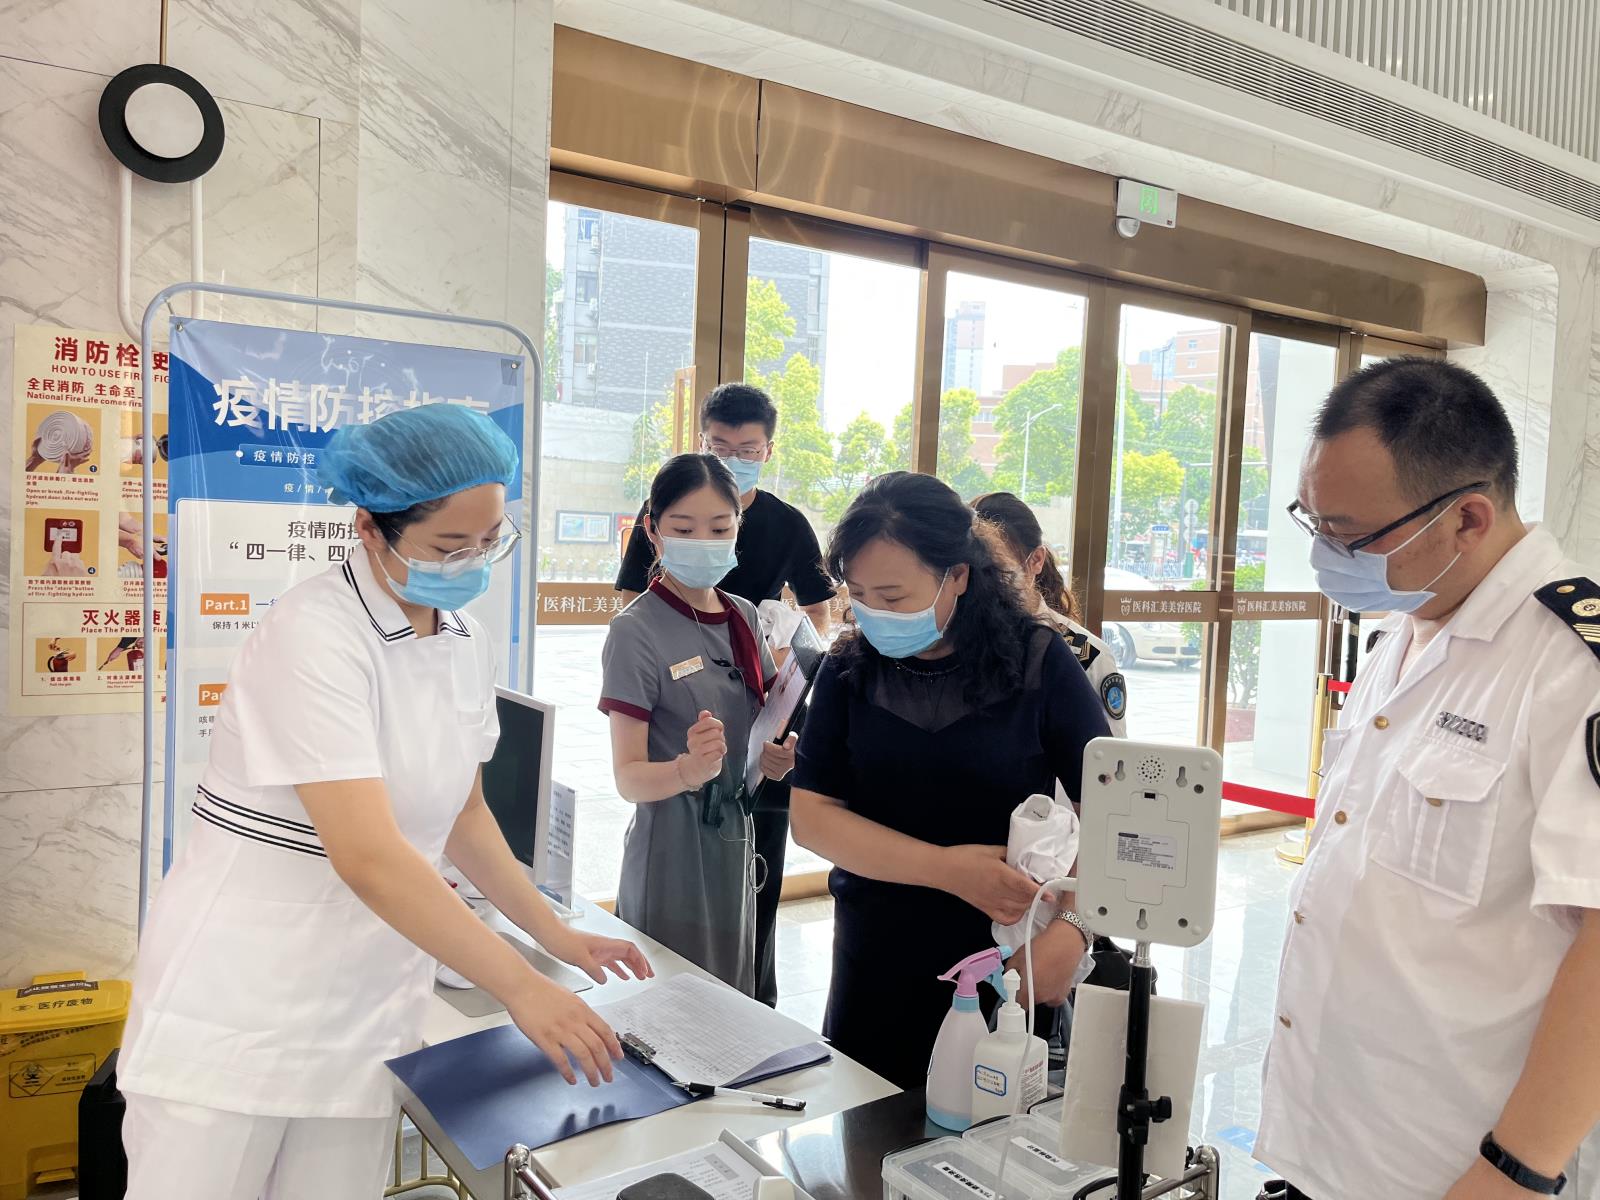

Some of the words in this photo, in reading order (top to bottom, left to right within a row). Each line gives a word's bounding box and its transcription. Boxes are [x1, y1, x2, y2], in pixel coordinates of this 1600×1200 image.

[52, 364, 78, 375] HOW
[81, 367, 95, 376] TO
[99, 369, 121, 379] USE
[27, 377, 84, 394] 全民消防
[94, 383, 142, 399] 生命至
[26, 391, 64, 400] National
[65, 394, 82, 402] Fire
[213, 376, 489, 433] 疫情防控
[253, 449, 316, 465] 疫情防控
[205, 599, 248, 611] Part.1
[1132, 600, 1202, 614] 医科汇美美容医院
[1247, 600, 1307, 612] 医科汇美美容医院
[38, 998, 93, 1010] 医疗废物
